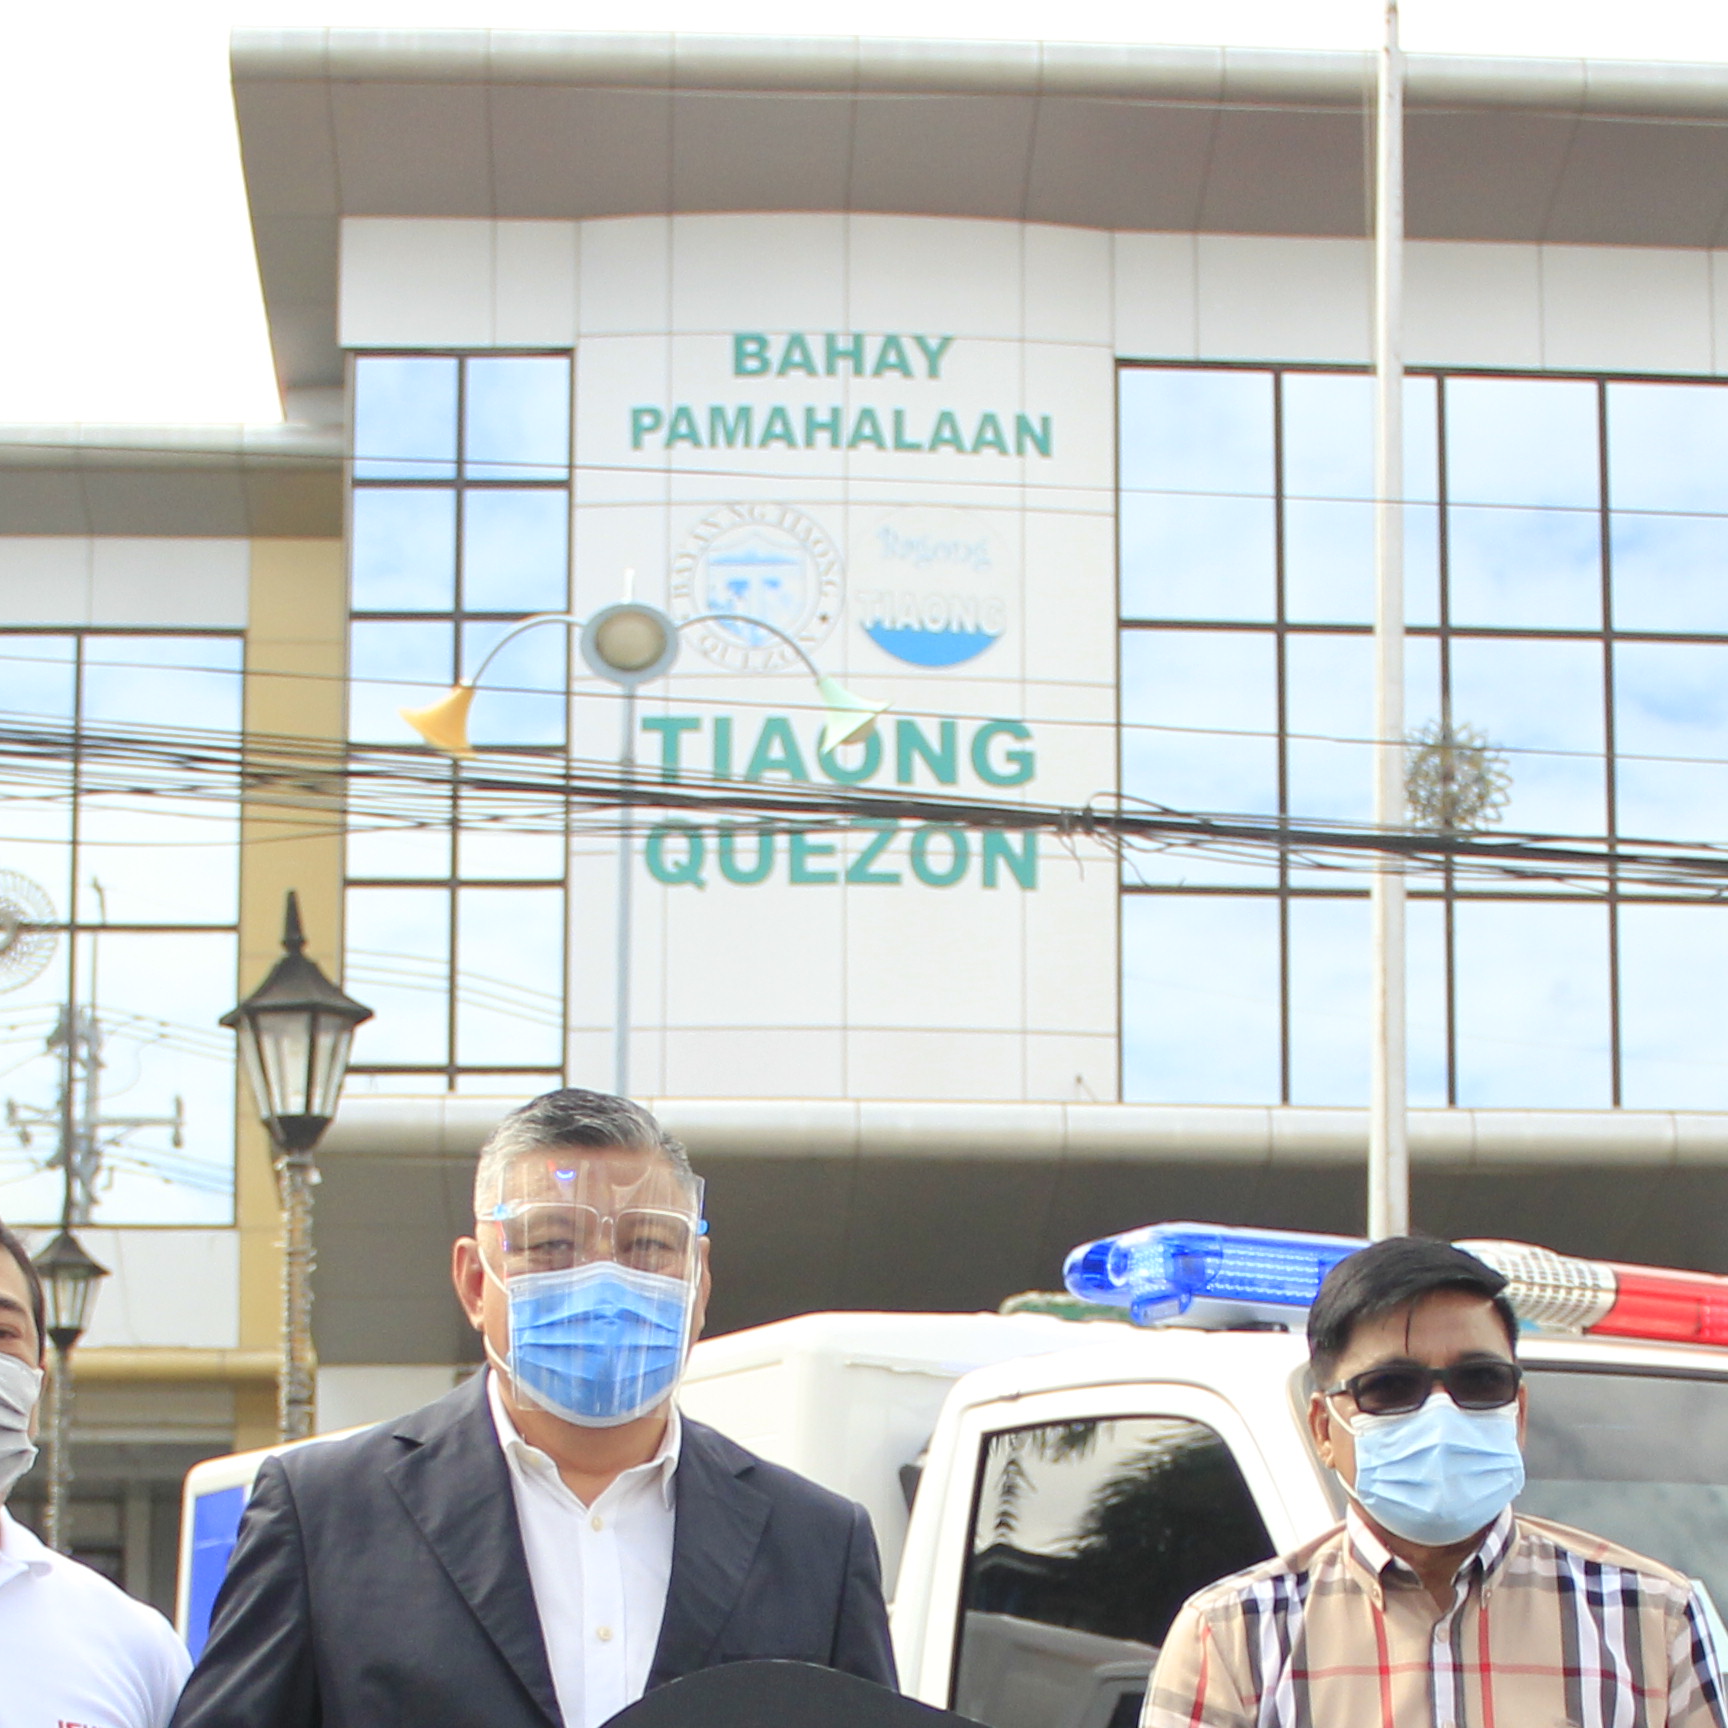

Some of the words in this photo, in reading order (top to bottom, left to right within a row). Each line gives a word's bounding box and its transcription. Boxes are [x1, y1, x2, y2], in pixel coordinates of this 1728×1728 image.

[733, 331, 955, 380] BAHAY
[630, 405, 1053, 458] PAMAHALAAN
[855, 588, 1008, 637] TIAONG
[641, 715, 1037, 788] TIAONG
[644, 818, 1040, 892] QUEZON
